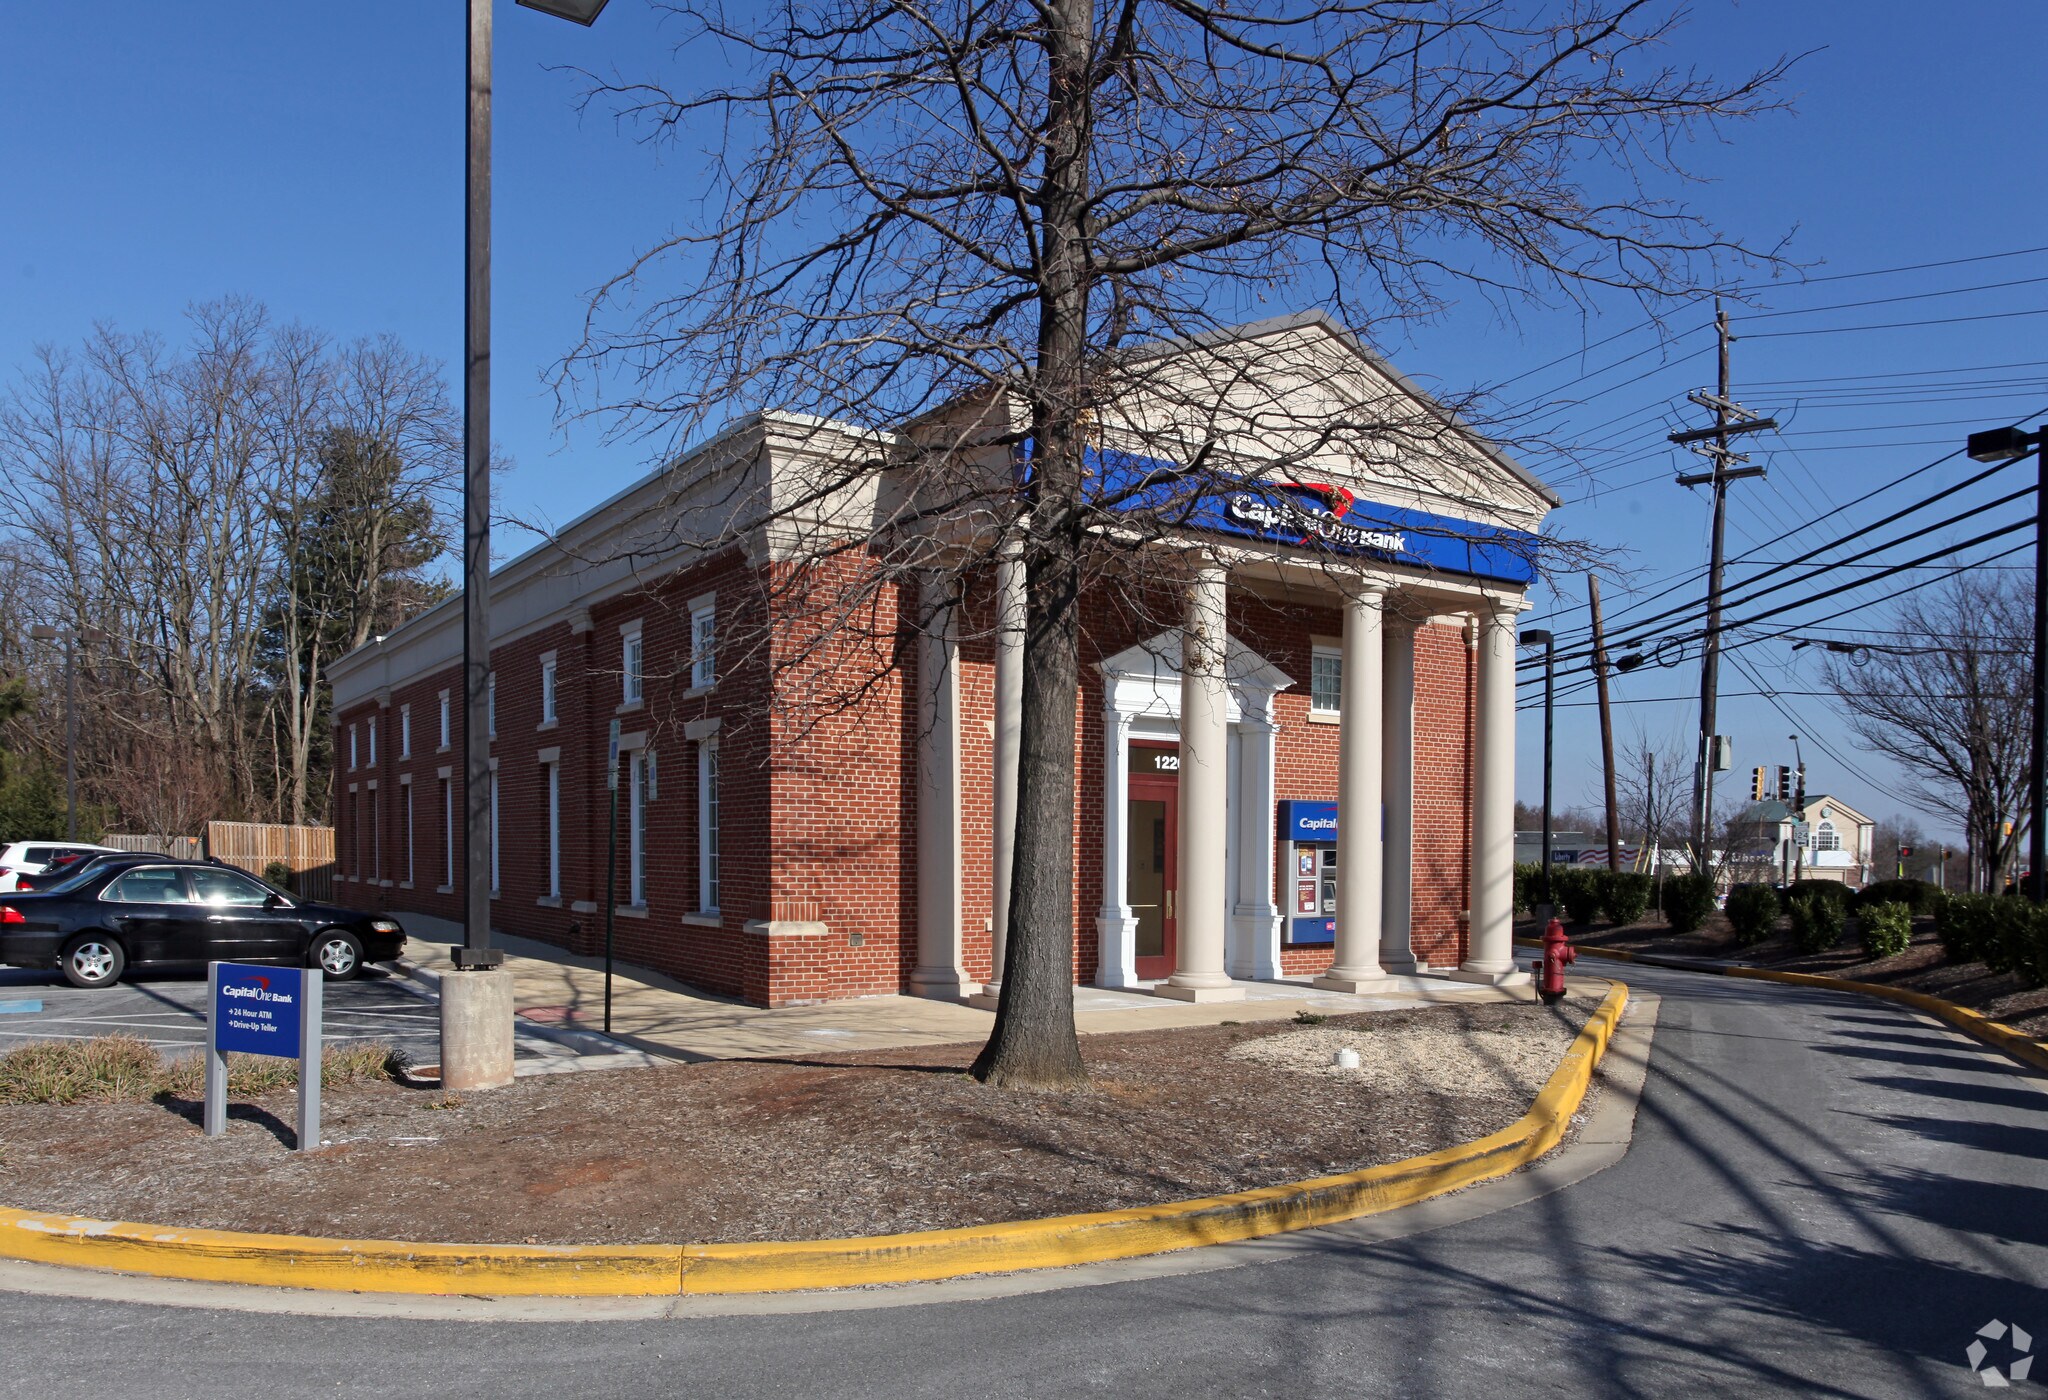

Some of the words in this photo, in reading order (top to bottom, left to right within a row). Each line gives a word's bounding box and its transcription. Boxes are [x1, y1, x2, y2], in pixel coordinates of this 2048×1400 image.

[1360, 530, 1406, 552] Bank
[1154, 755, 1180, 770] 122
[272, 993, 293, 1004] Bank
[233, 1008, 242, 1016] 24
[242, 1009, 258, 1018] Hour
[258, 1011, 273, 1019] ATM
[233, 1021, 260, 1032] Drive-Up
[260, 1023, 278, 1032] Teller
